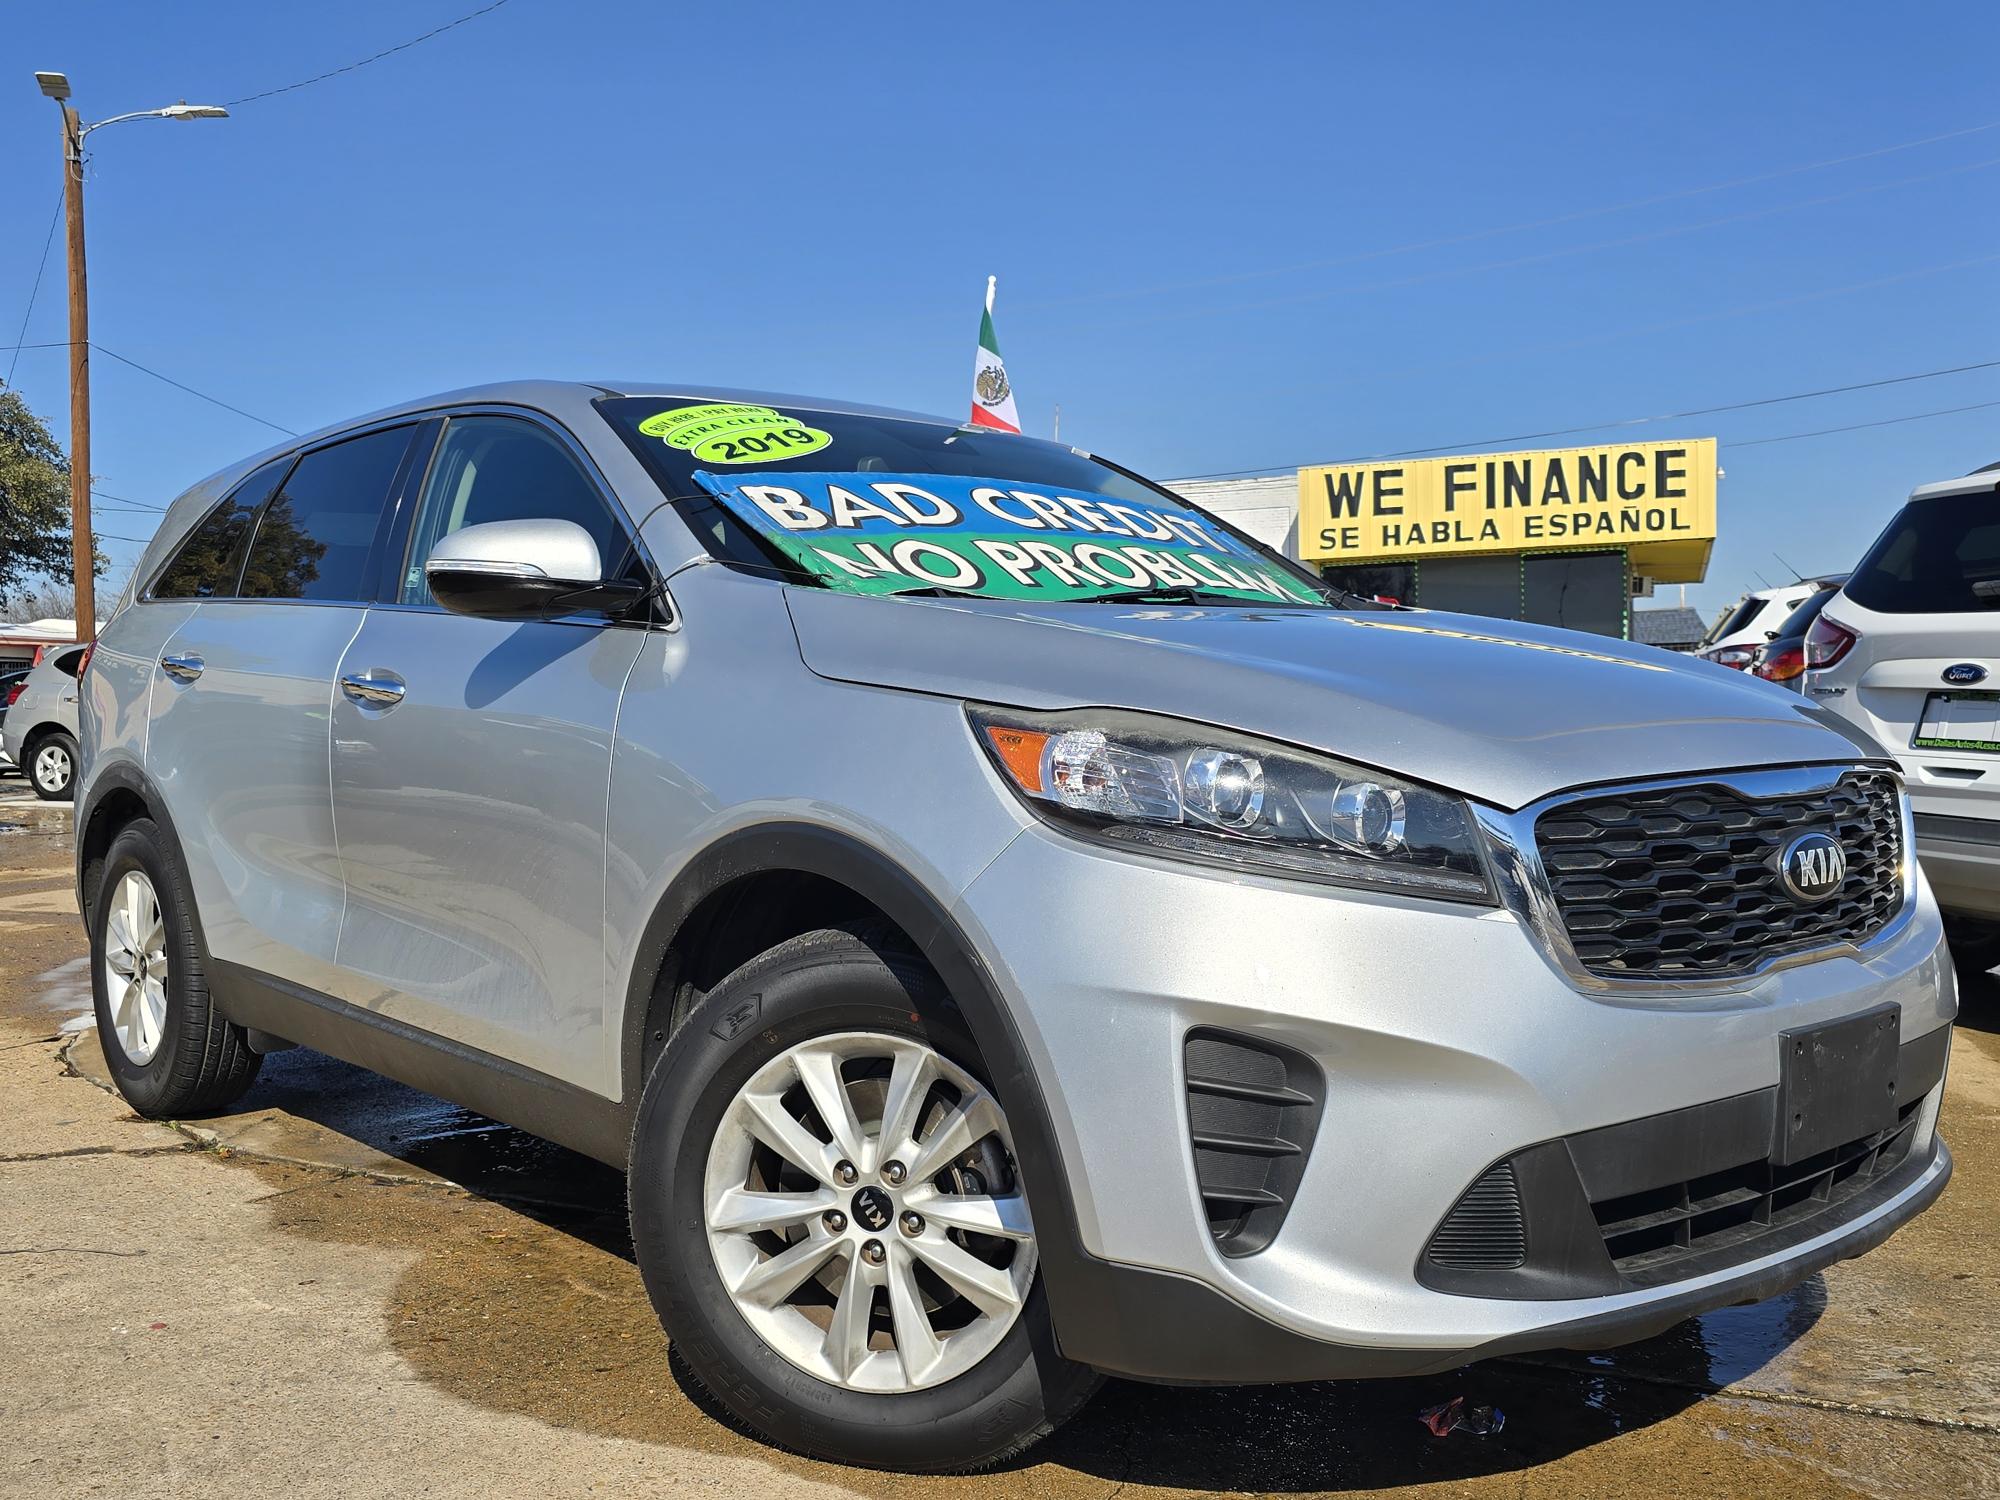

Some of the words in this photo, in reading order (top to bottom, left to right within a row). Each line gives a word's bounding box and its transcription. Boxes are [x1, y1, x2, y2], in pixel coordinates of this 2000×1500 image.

[674, 423, 722, 446] EXTRA
[726, 417, 790, 426] CLEAN
[711, 428, 815, 460] 2019
[1324, 468, 1405, 519] WE
[1444, 449, 1687, 512] FINANCE
[739, 482, 962, 530] BAD
[969, 487, 1230, 553] CREDIT
[1319, 526, 1360, 550] SE
[1381, 518, 1501, 547] HABLA
[1524, 505, 1691, 539] ESPAÑOL
[809, 539, 985, 589] NO
[970, 539, 1314, 606] PROBLEM
[1948, 667, 1976, 680] Ford
[1797, 846, 1842, 887] KIA
[858, 1190, 887, 1229] KIA
